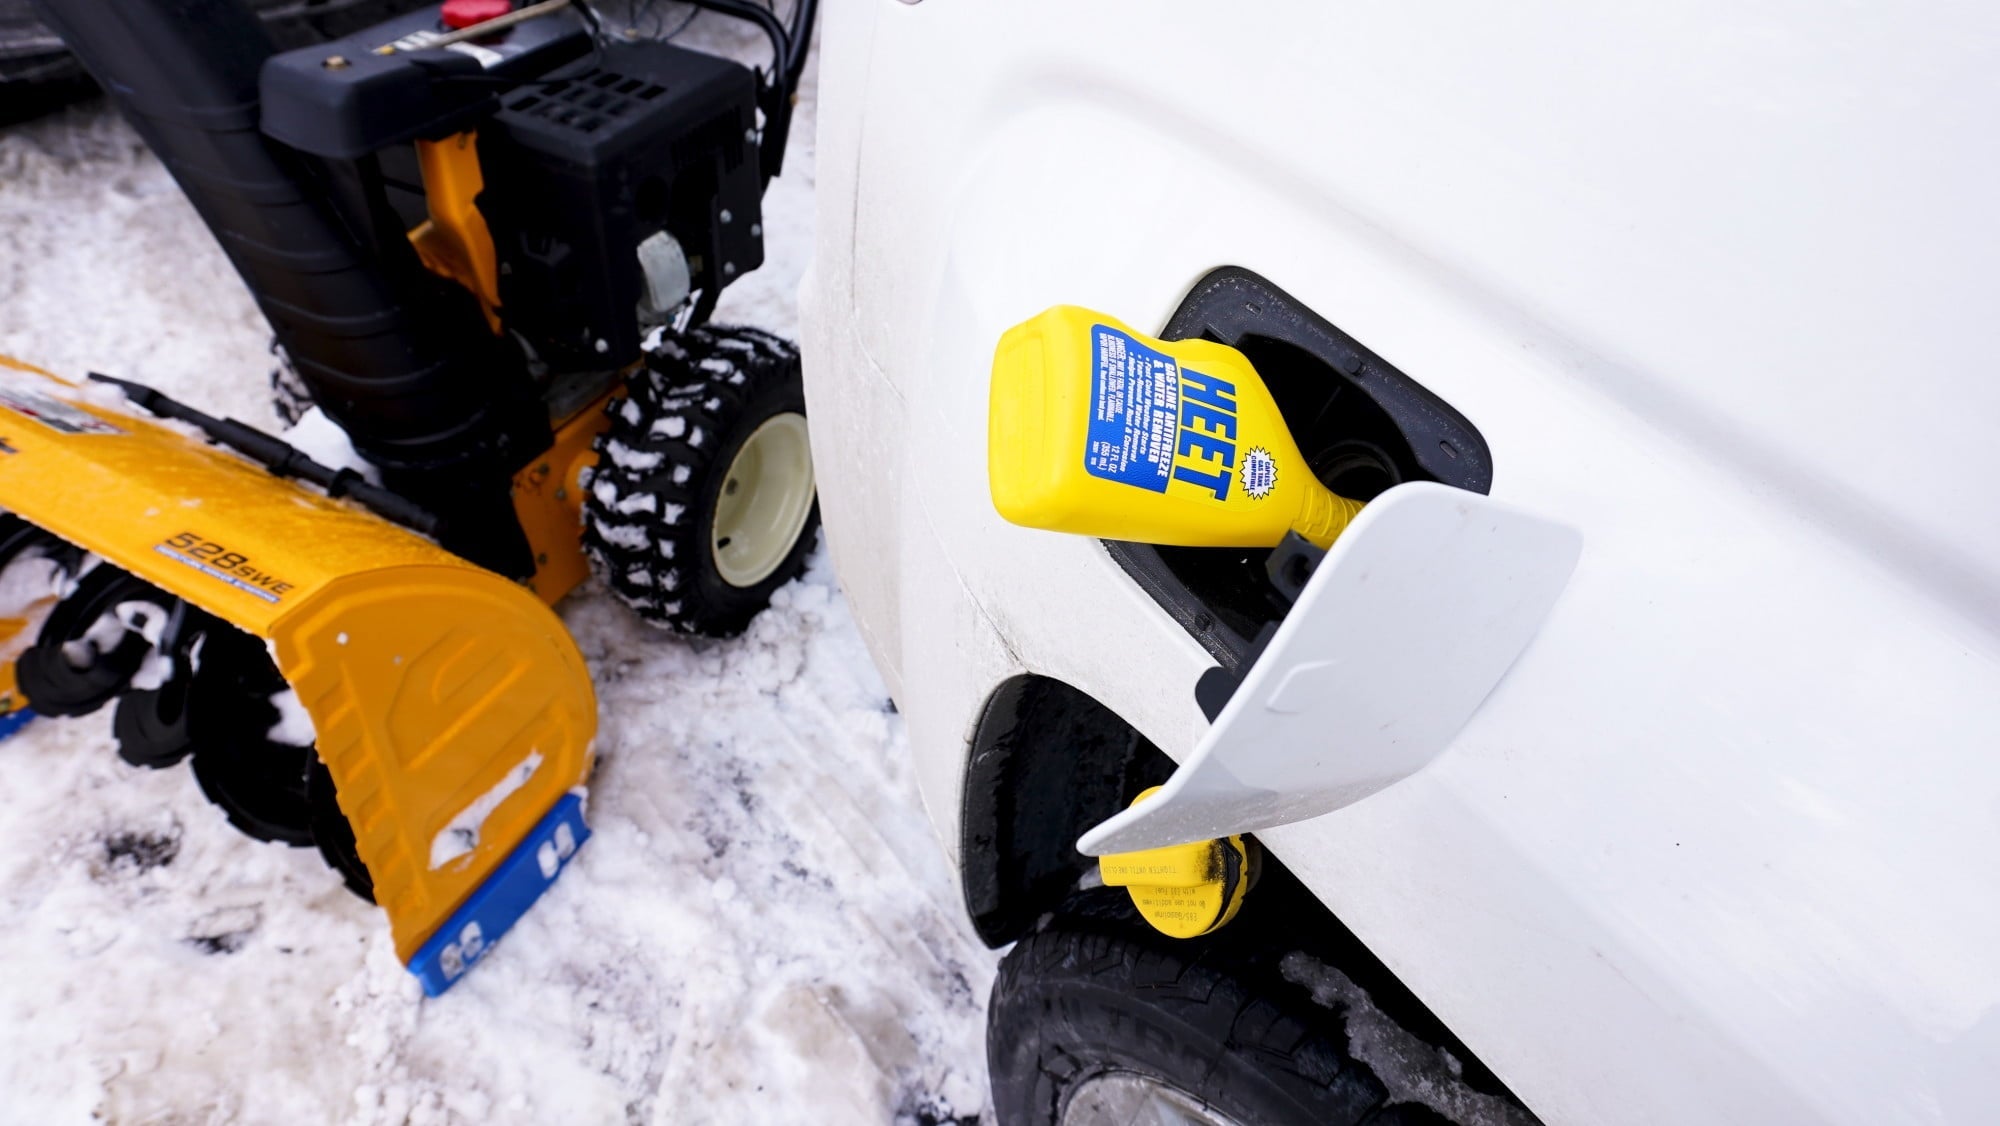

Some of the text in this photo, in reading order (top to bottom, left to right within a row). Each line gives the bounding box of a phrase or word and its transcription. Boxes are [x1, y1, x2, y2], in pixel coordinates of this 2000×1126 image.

[1116, 338, 1126, 360] DANGER:
[1144, 379, 1152, 398] Cold
[1120, 356, 1136, 472] Helps Prevent Rust & Corrosion
[1130, 360, 1144, 463] Year-Round Water Removal
[1142, 397, 1152, 431] Weather
[1148, 360, 1165, 463] & WATER REMOVER
[1156, 362, 1176, 478] GAS-LINE ANTIFREEZE
[1140, 431, 1149, 455] Starts
[1174, 366, 1237, 502] HEET
[1097, 442, 1110, 470] (355 mL)
[1108, 445, 1120, 474] 12 FL OZ
[1256, 472, 1264, 487] TANK
[1130, 865, 1148, 874] UNTIL
[1154, 911, 1198, 922] E85/Gasoline
